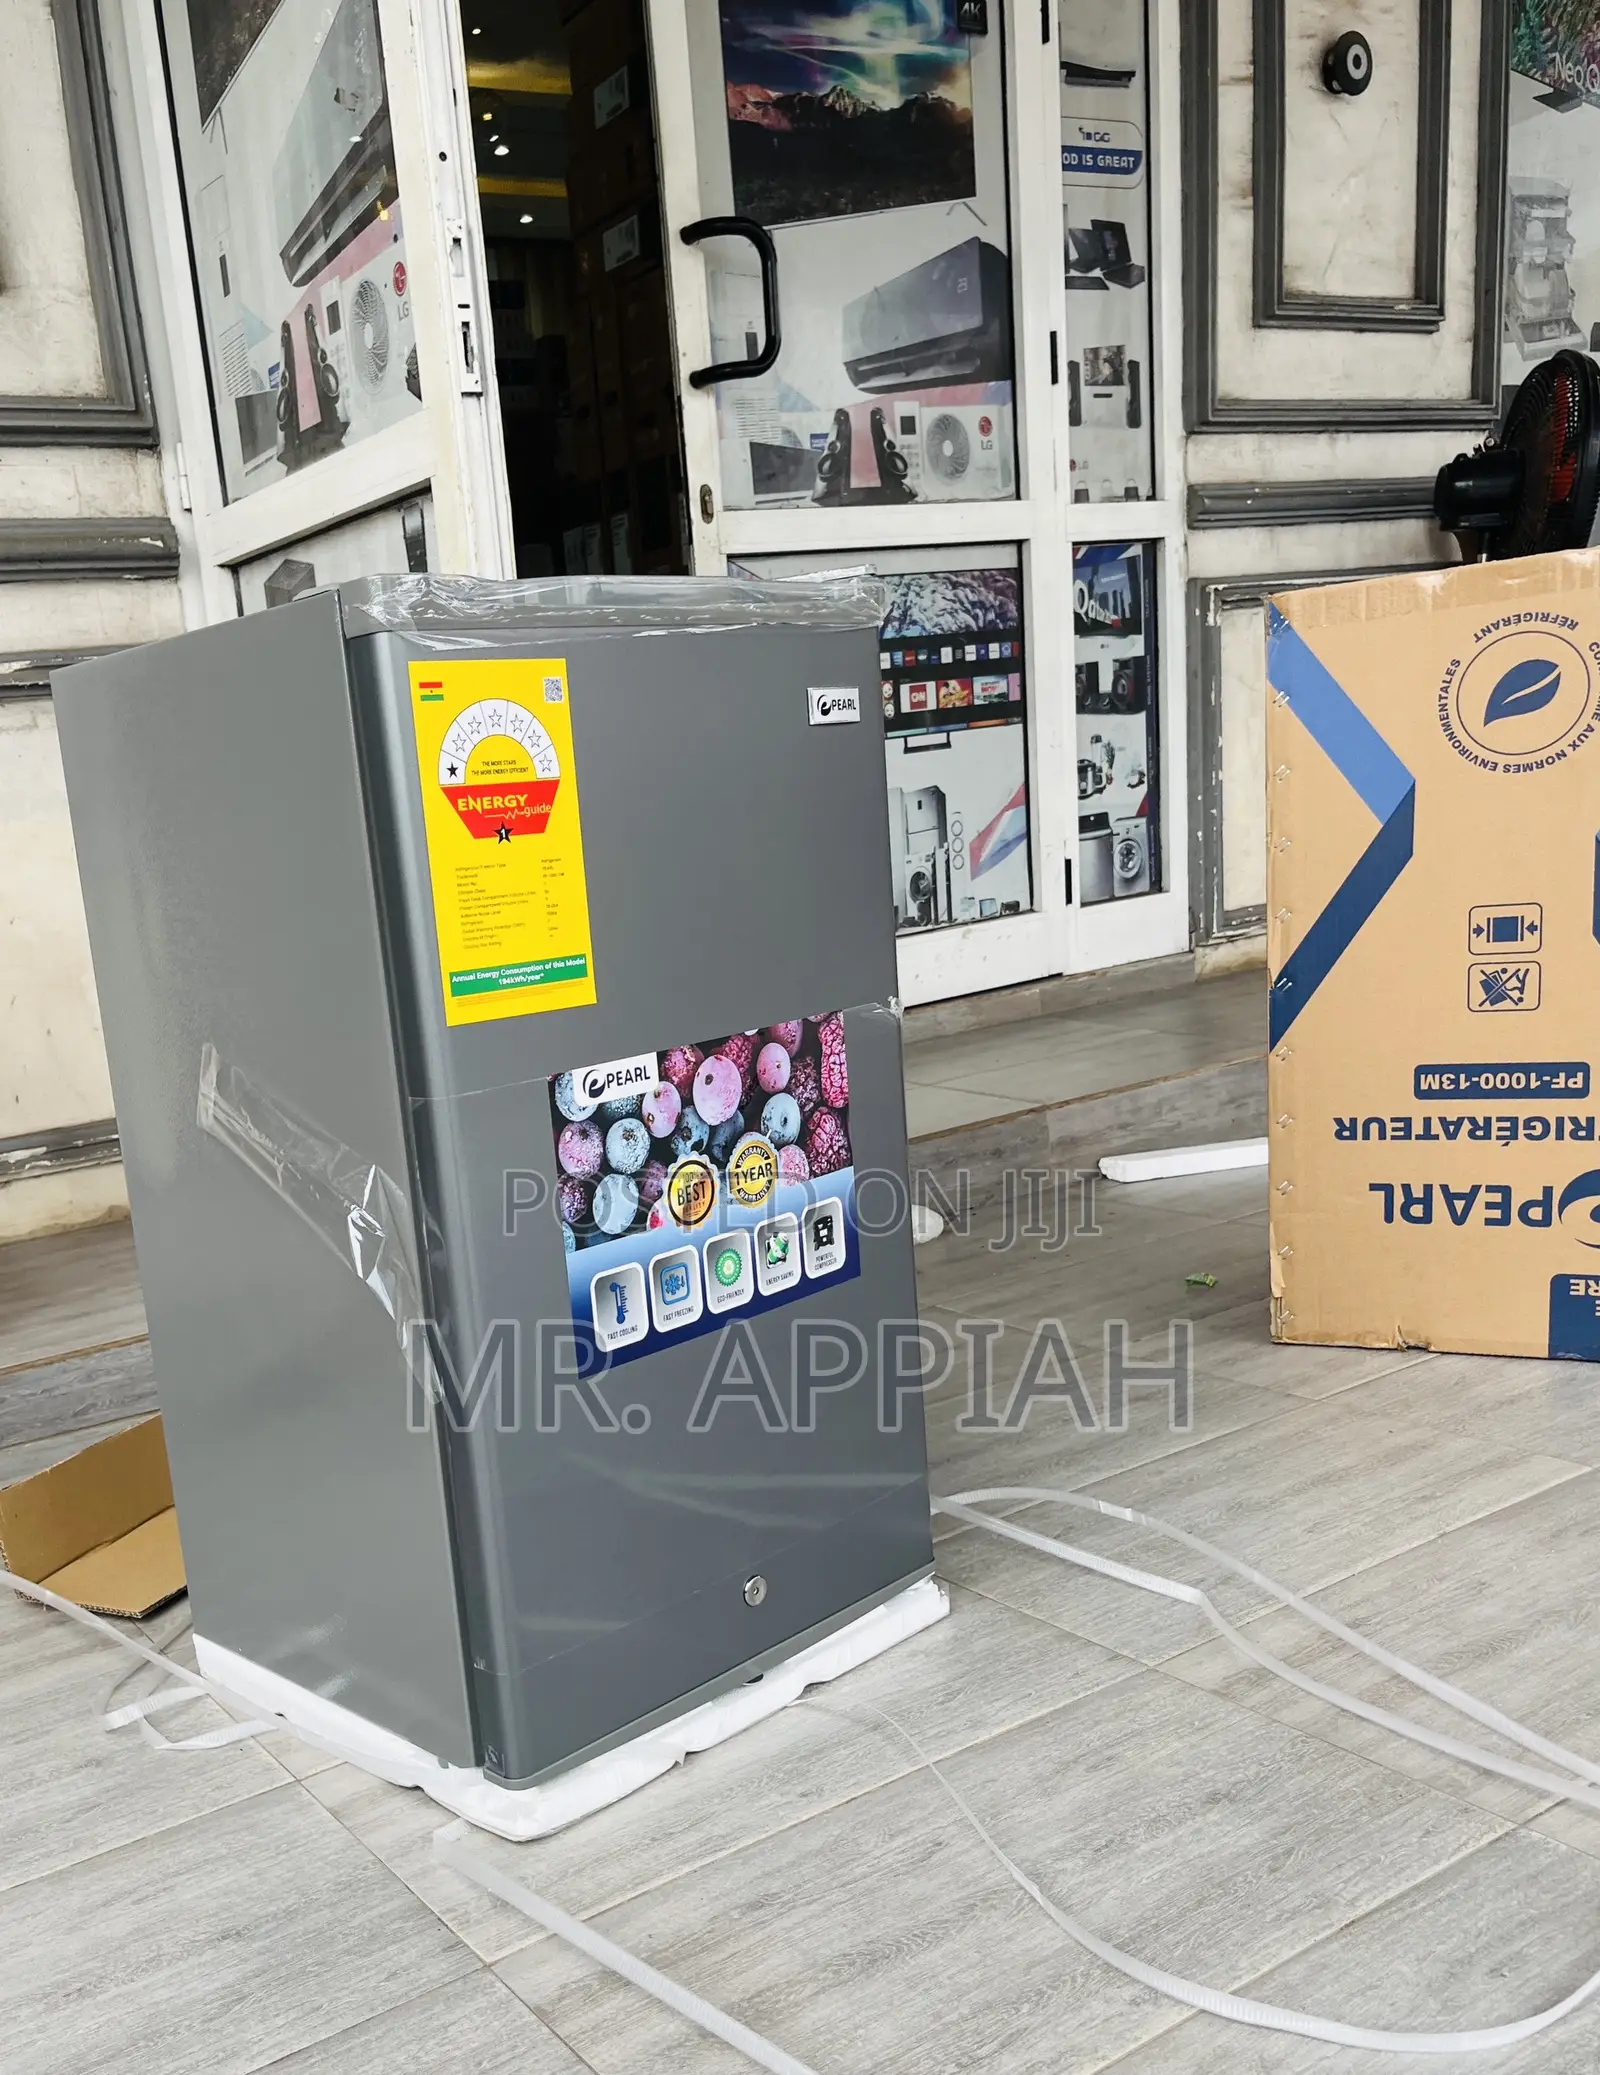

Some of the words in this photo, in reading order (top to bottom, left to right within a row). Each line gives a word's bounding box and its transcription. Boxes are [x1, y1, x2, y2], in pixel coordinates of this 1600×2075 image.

[1062, 152, 1079, 165] OD
[1082, 154, 1094, 166] IS
[1097, 155, 1135, 168] GREAT
[397, 301, 410, 321] LG
[980, 440, 993, 450] LG
[1473, 612, 1579, 643] RÉFRIGÉRANT
[831, 698, 857, 711] PEARL
[1438, 658, 1499, 772] ENVIRONMENTALES
[1568, 724, 1595, 752] AUX
[1502, 749, 1568, 774] NORMES
[457, 794, 528, 815] ENERGY
[523, 802, 552, 817] guide
[500, 828, 506, 838] 1
[451, 975, 476, 984] Annual
[476, 970, 500, 979] Energy
[500, 963, 544, 976] Consumption
[552, 960, 565, 969] this
[566, 957, 586, 967] Model
[606, 1065, 651, 1089] PEARL
[1420, 1071, 1584, 1091] PF-1000-13M
[1333, 1116, 1600, 1147] RIGÉRATEUR
[737, 1146, 768, 1166] WARRANTY
[677, 1181, 706, 1206] BEST
[739, 1181, 771, 1201] WARRANTY
[1369, 1183, 1554, 1228] PEARL
[717, 1289, 745, 1304] ECO-FRIENDLY
[663, 1313, 674, 1322] FAST
[607, 1331, 618, 1341] FAST
[619, 1325, 638, 1338] COOLING
